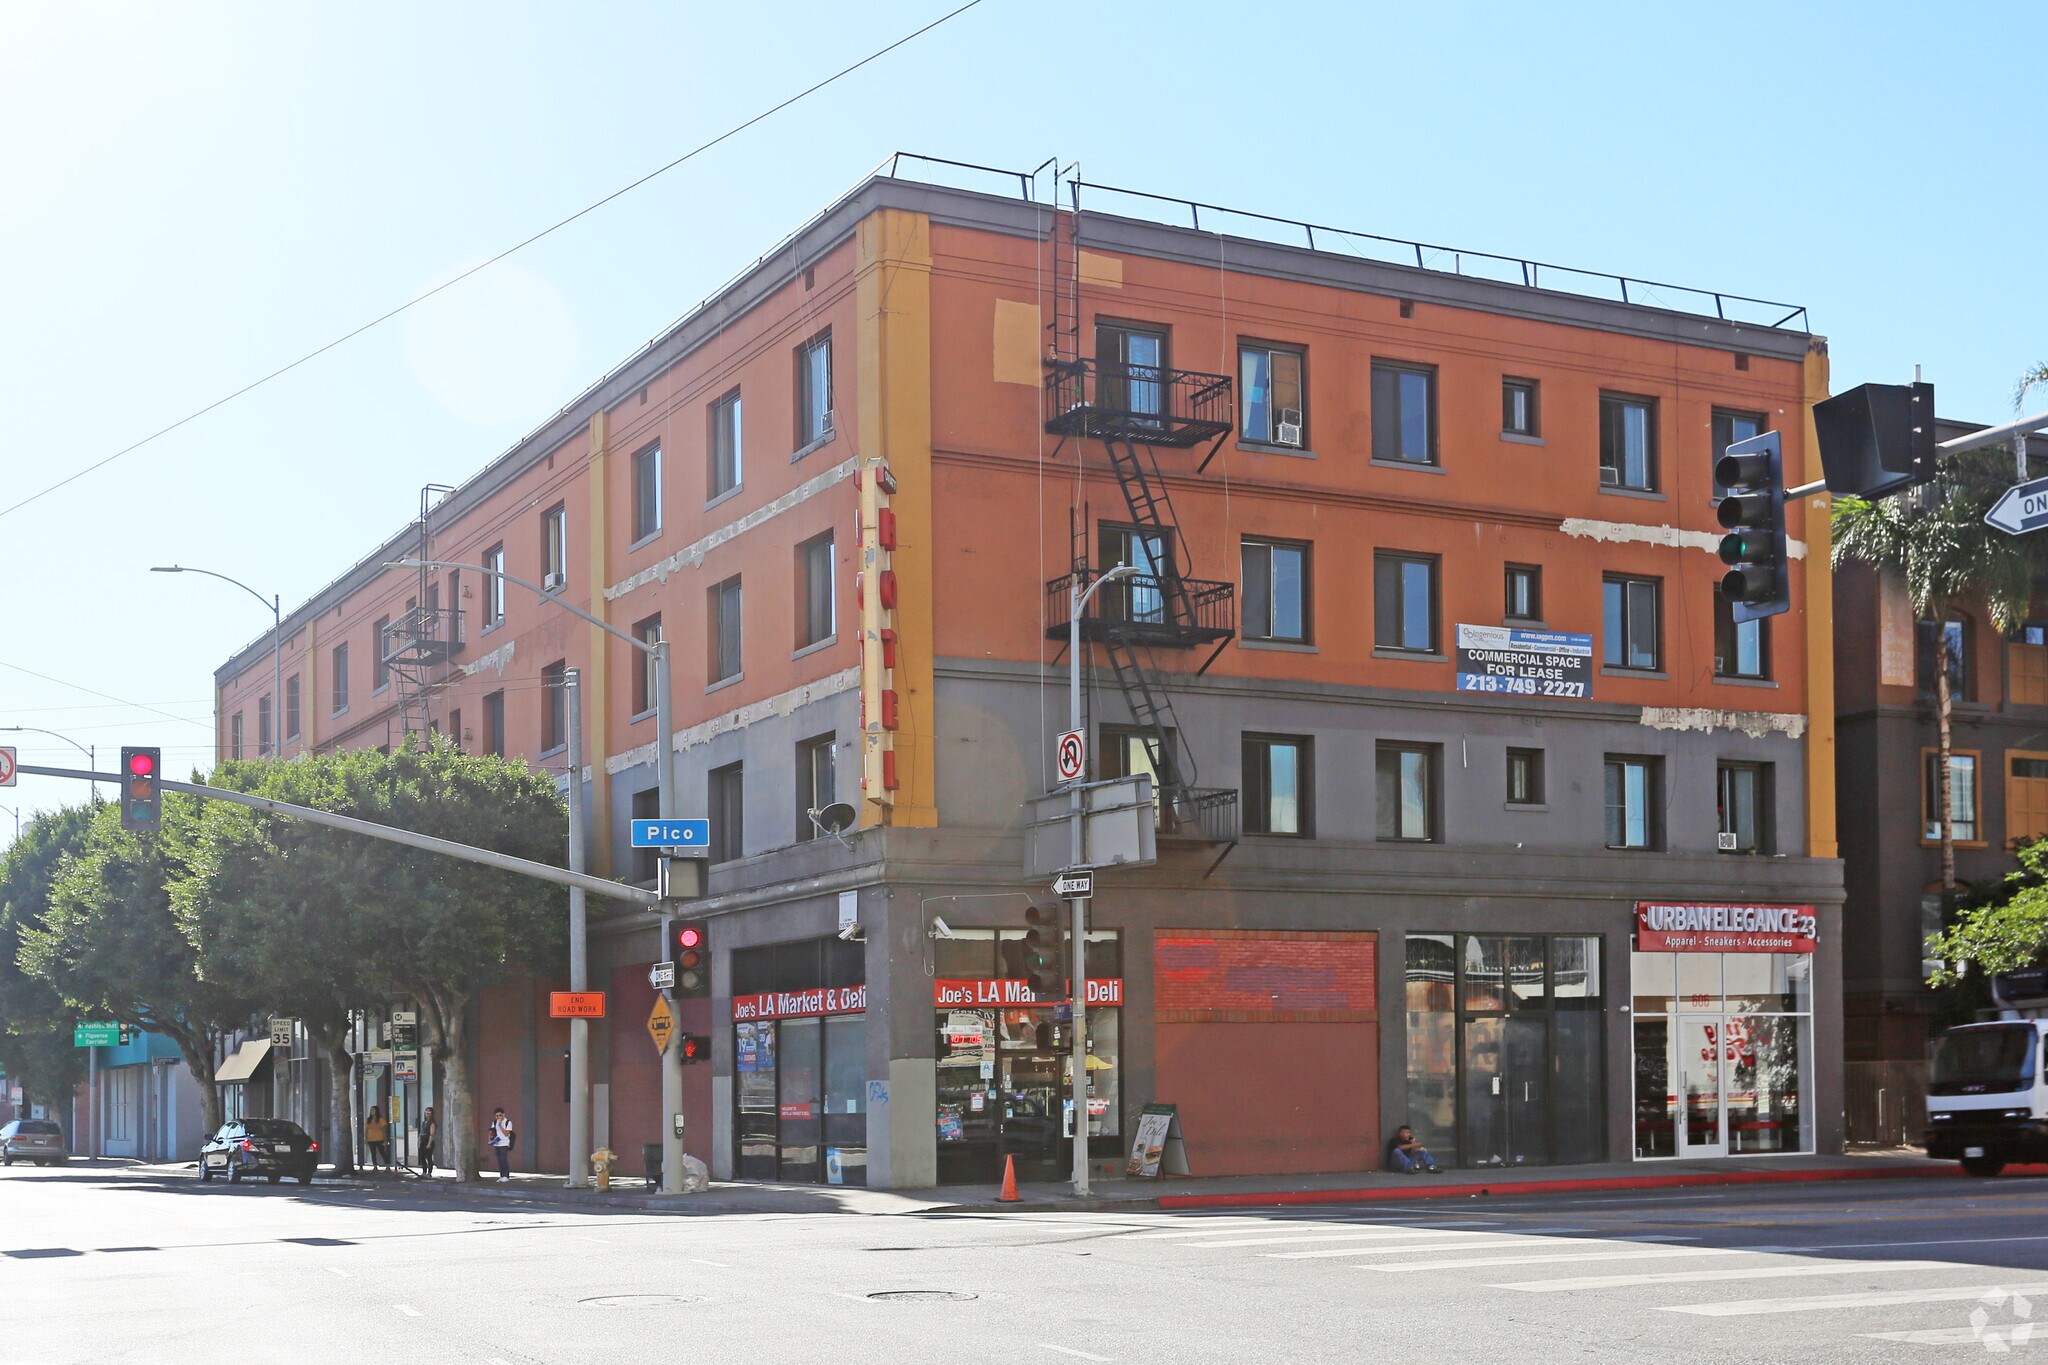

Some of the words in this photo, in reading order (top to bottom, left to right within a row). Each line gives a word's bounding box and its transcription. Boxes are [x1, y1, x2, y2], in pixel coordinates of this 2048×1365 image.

[1468, 649, 1543, 666] COMMERCIAL
[1545, 656, 1581, 668] SPACE
[1486, 663, 1515, 676] FOR
[1519, 667, 1563, 680] LEASE
[647, 826, 694, 841] Pico
[1062, 881, 1075, 891] ONE
[1076, 879, 1089, 890] WAY
[1665, 935, 1697, 947] Apparel
[1704, 936, 1741, 947] Sneakers
[1747, 936, 1793, 947] Accessories
[938, 986, 973, 1004] Joe's
[978, 981, 1000, 1003] LA
[1087, 981, 1119, 1003] Deli
[570, 996, 585, 1004] END
[735, 1002, 757, 1018] Joe's
[759, 995, 775, 1016] LA
[777, 991, 824, 1015] Market
[826, 989, 837, 1011] &
[841, 985, 866, 1010] Deli
[1691, 994, 1710, 1008] 606
[577, 1005, 597, 1013] WORK
[272, 1033, 290, 1045] 35
[1142, 1116, 1163, 1127] Joe's
[1146, 1123, 1167, 1136] Deli
